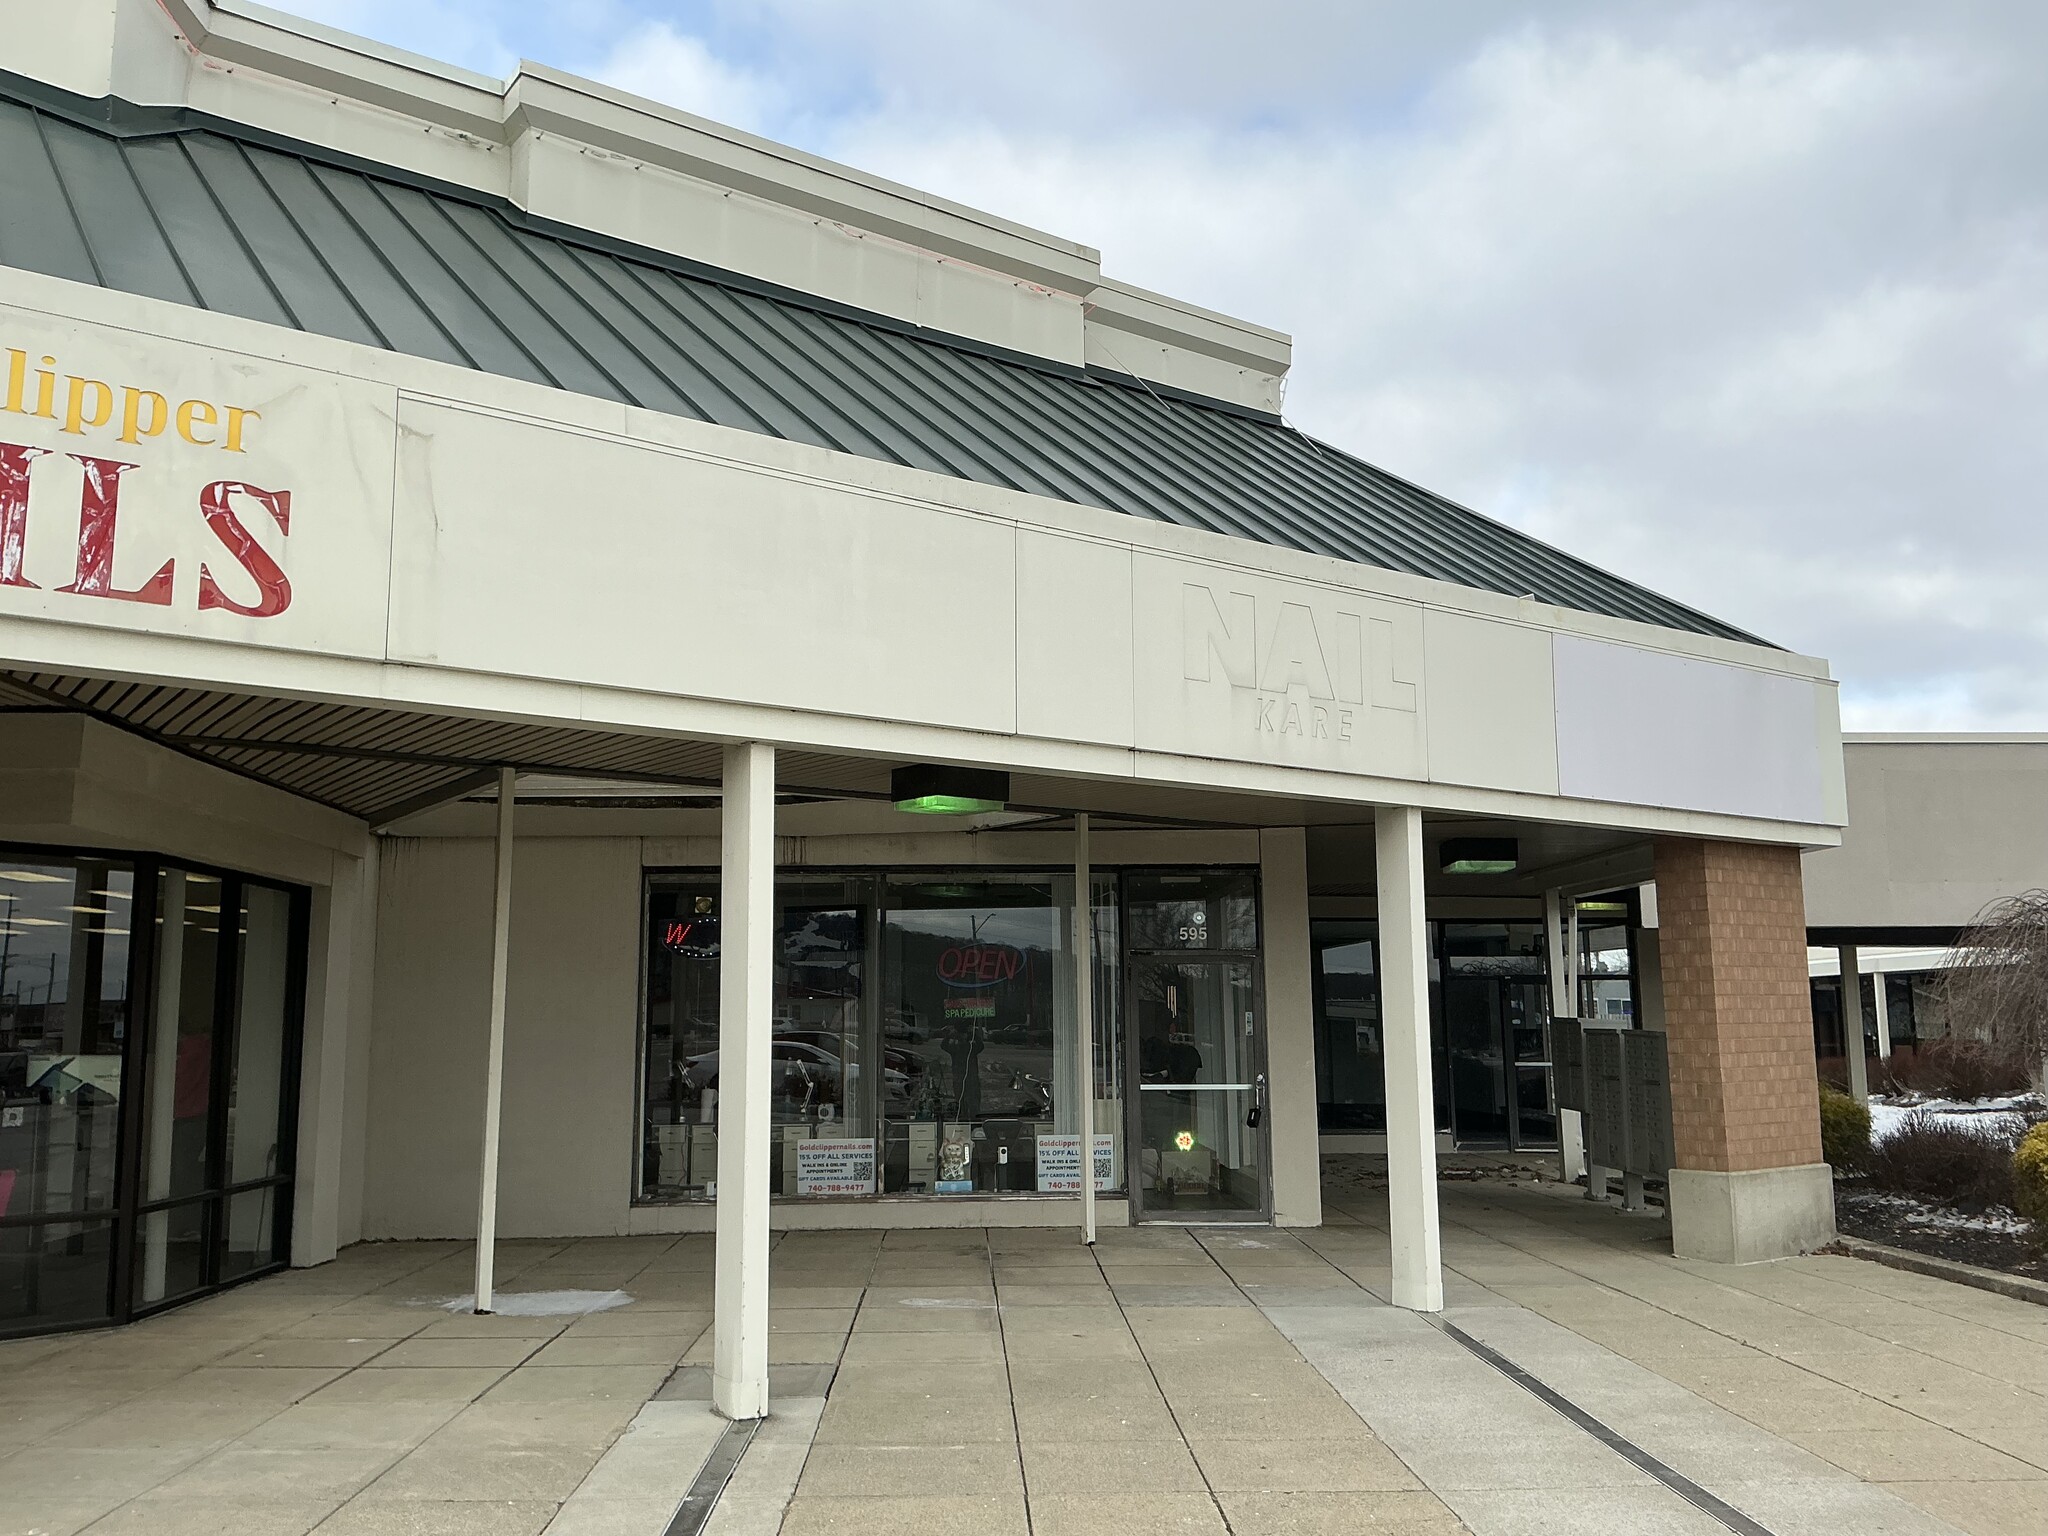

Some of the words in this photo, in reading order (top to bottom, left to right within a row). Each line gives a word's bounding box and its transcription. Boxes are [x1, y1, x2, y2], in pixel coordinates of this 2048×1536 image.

[1183, 582, 1416, 713] NAIL
[1255, 698, 1352, 741] KARE
[1179, 927, 1207, 940] 595
[939, 948, 1018, 979] OPEN
[945, 1009, 960, 1018] SPA
[960, 1007, 995, 1018] PEDICURE
[1039, 1140, 1111, 1148] Goldclipper.com
[808, 1184, 864, 1192] 740-788-9477
[1048, 1181, 1103, 1189] 740-78877
